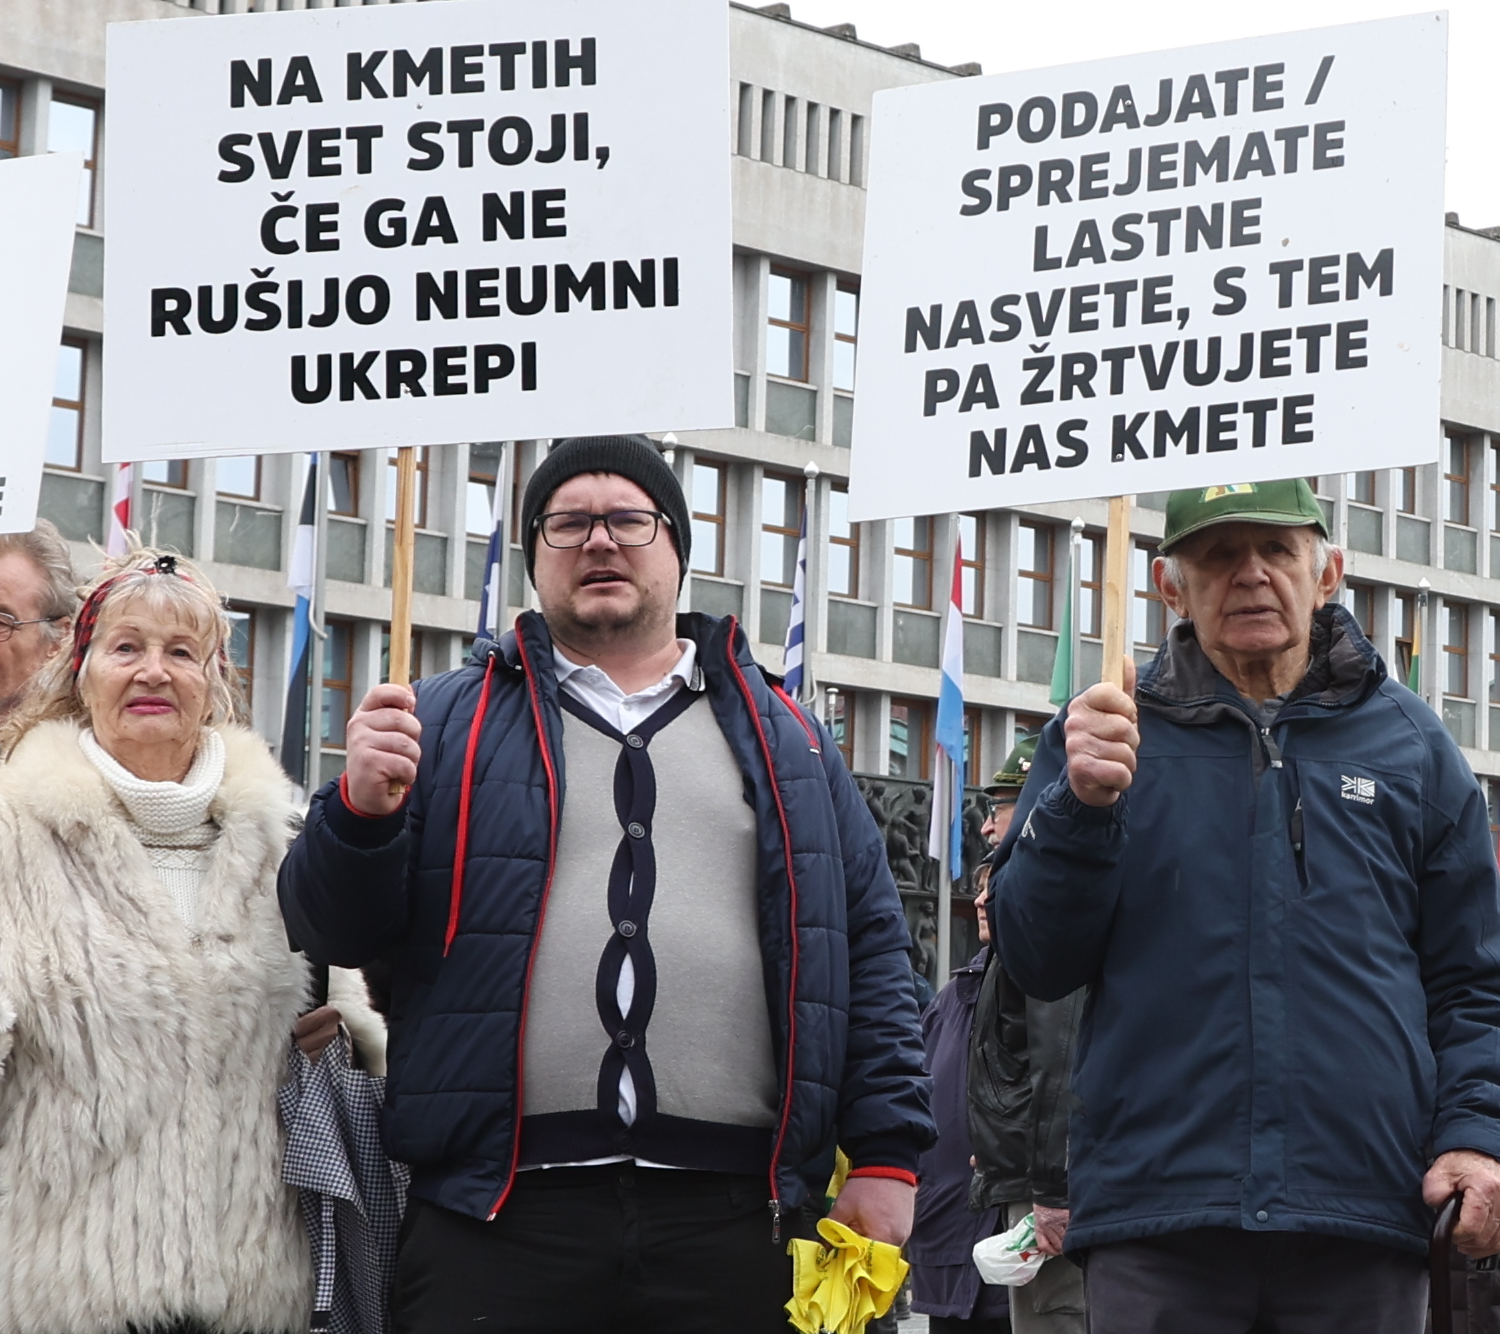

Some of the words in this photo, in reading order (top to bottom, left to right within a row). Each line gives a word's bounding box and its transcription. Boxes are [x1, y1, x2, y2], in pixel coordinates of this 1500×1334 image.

[229, 54, 325, 110] NA
[345, 36, 598, 102] KMETIH
[976, 62, 1285, 152] PODAJATE
[1304, 55, 1335, 106] /
[216, 123, 385, 185] SVET
[405, 111, 611, 173] STOJI,
[958, 120, 1346, 217] SPREJEMATE
[259, 189, 341, 256] ČE
[362, 194, 460, 250] GA
[481, 187, 568, 243] NE
[1032, 197, 1263, 273] LASTNE
[149, 265, 392, 339] RUŠIJO
[414, 256, 680, 323] NEUMNI
[903, 274, 1191, 355] NASVETE,
[1211, 265, 1248, 317] S
[1268, 247, 1395, 310] TEM
[290, 340, 538, 406] UKREPI
[922, 362, 1001, 418] PA
[1019, 318, 1369, 407] ŽRTVUJETE
[967, 417, 1090, 479] NAS
[1110, 393, 1315, 464] KMETE
